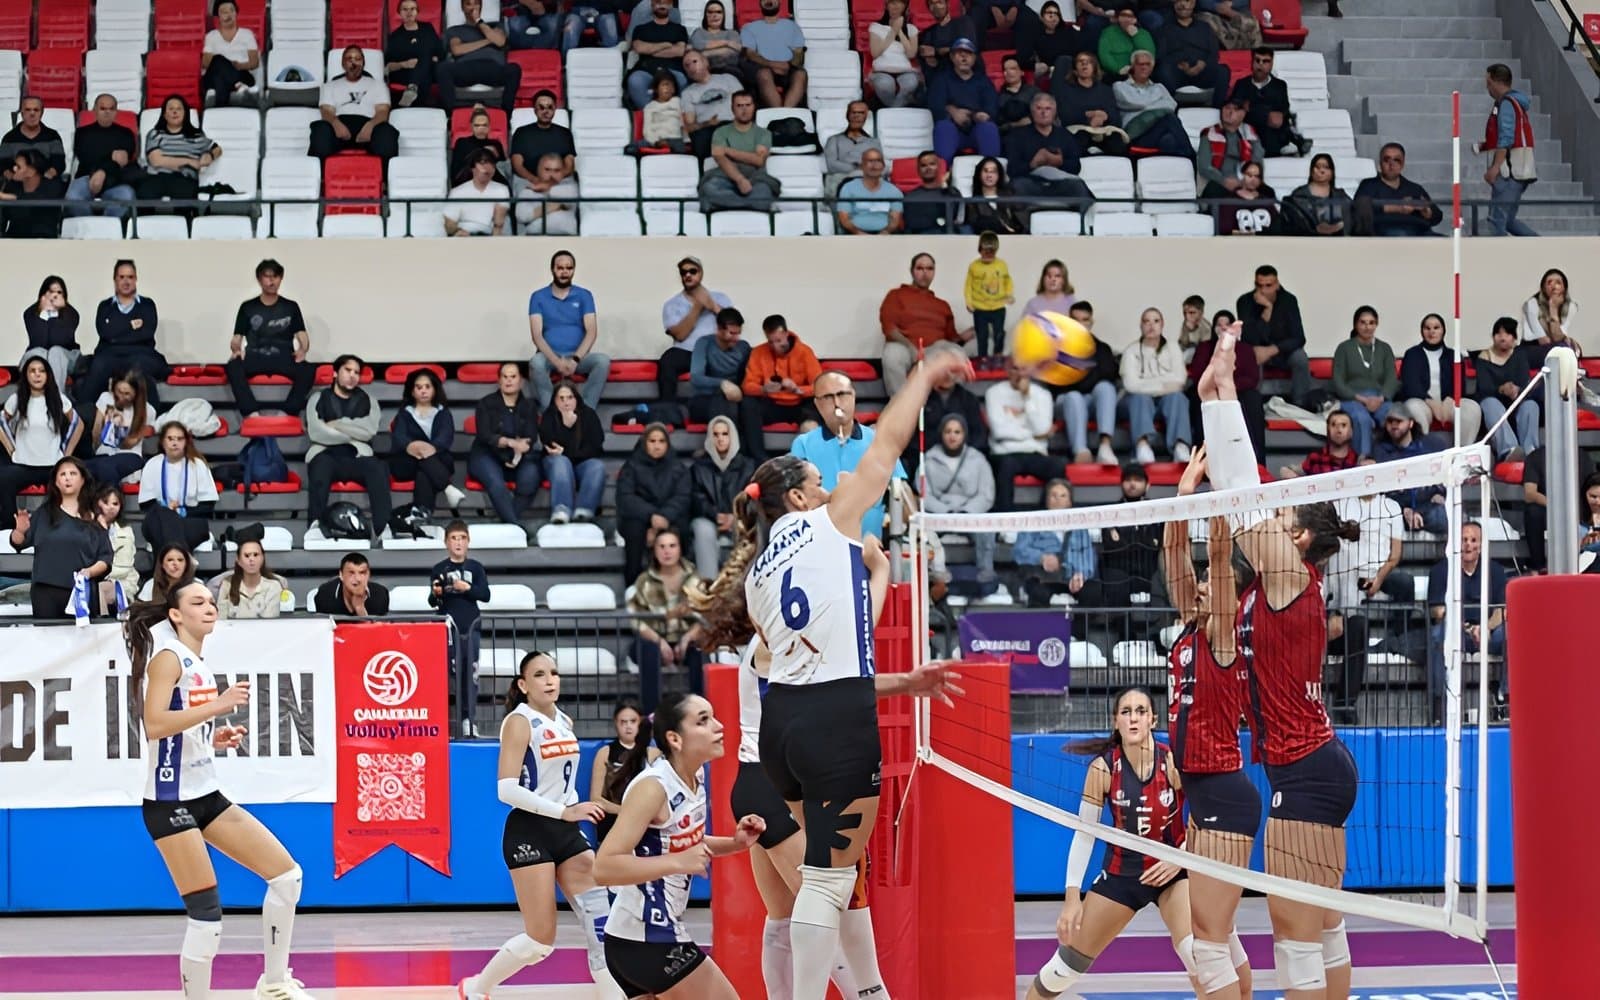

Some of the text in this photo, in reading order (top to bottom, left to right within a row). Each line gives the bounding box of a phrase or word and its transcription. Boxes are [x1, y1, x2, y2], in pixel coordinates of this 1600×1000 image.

[780, 566, 811, 631] 6
[0, 658, 316, 763] DE İNIN
[563, 759, 573, 794] 9
